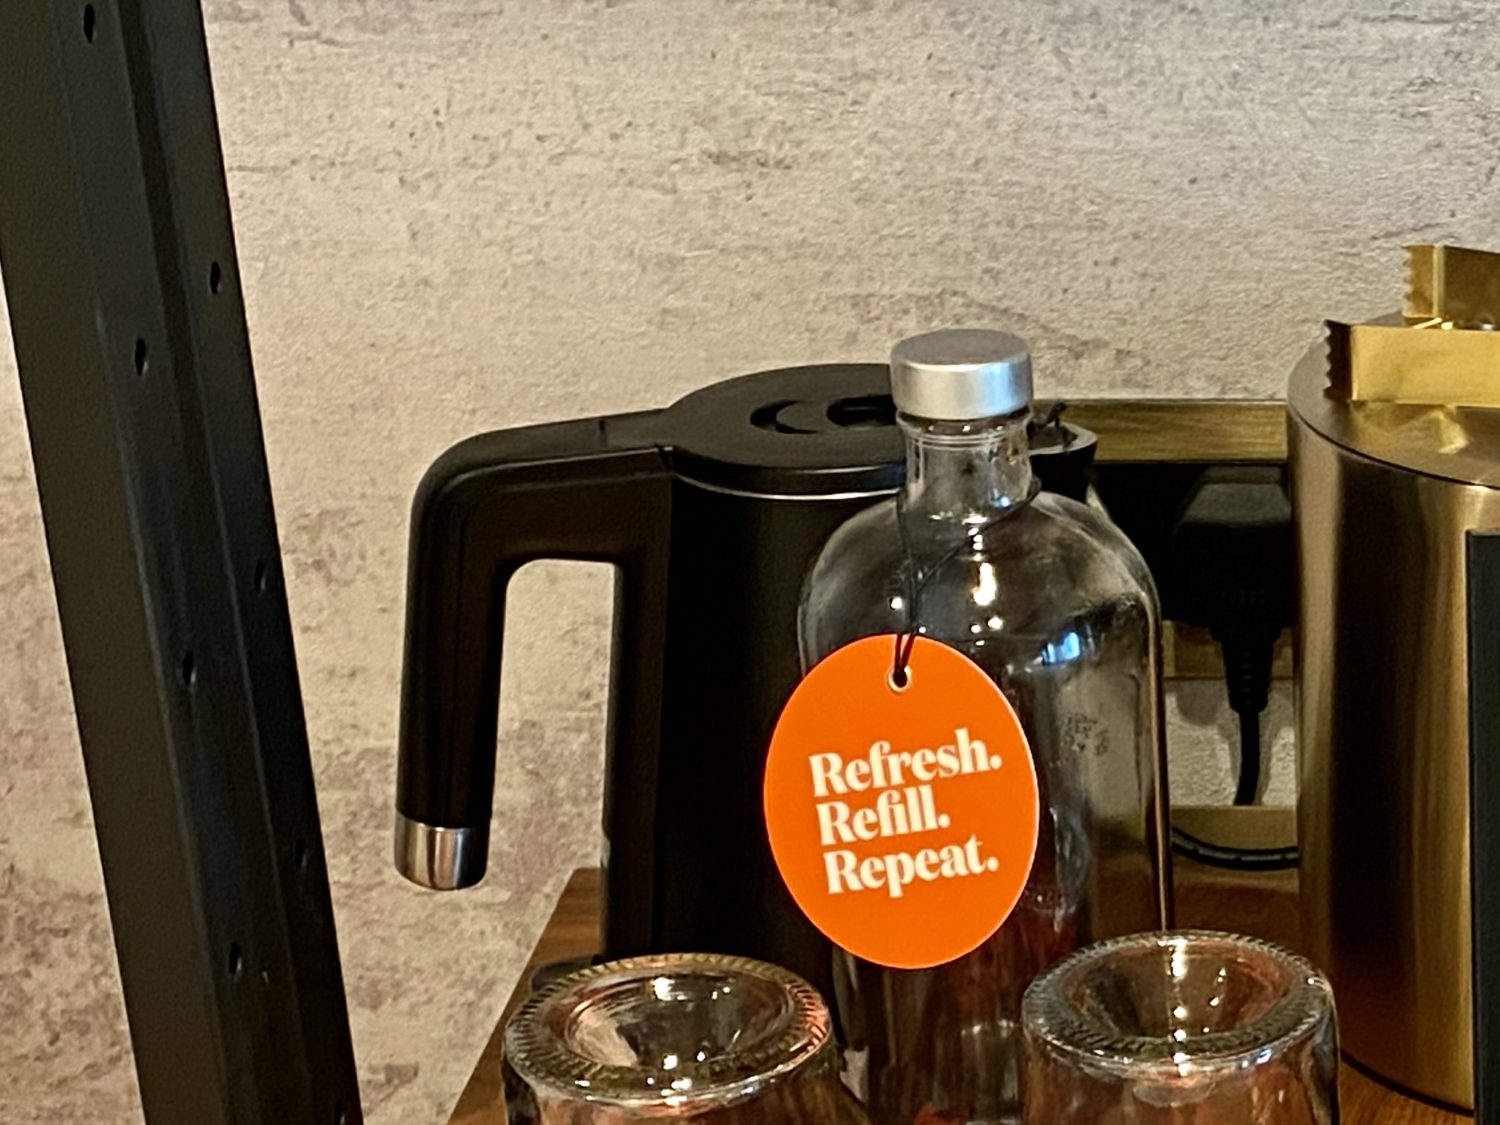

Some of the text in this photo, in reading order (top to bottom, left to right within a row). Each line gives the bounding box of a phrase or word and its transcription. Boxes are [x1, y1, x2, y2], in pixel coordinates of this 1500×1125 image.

[808, 727, 1002, 797] Refresh.
[815, 784, 950, 846] Refill.
[823, 834, 999, 899] Repeat.
